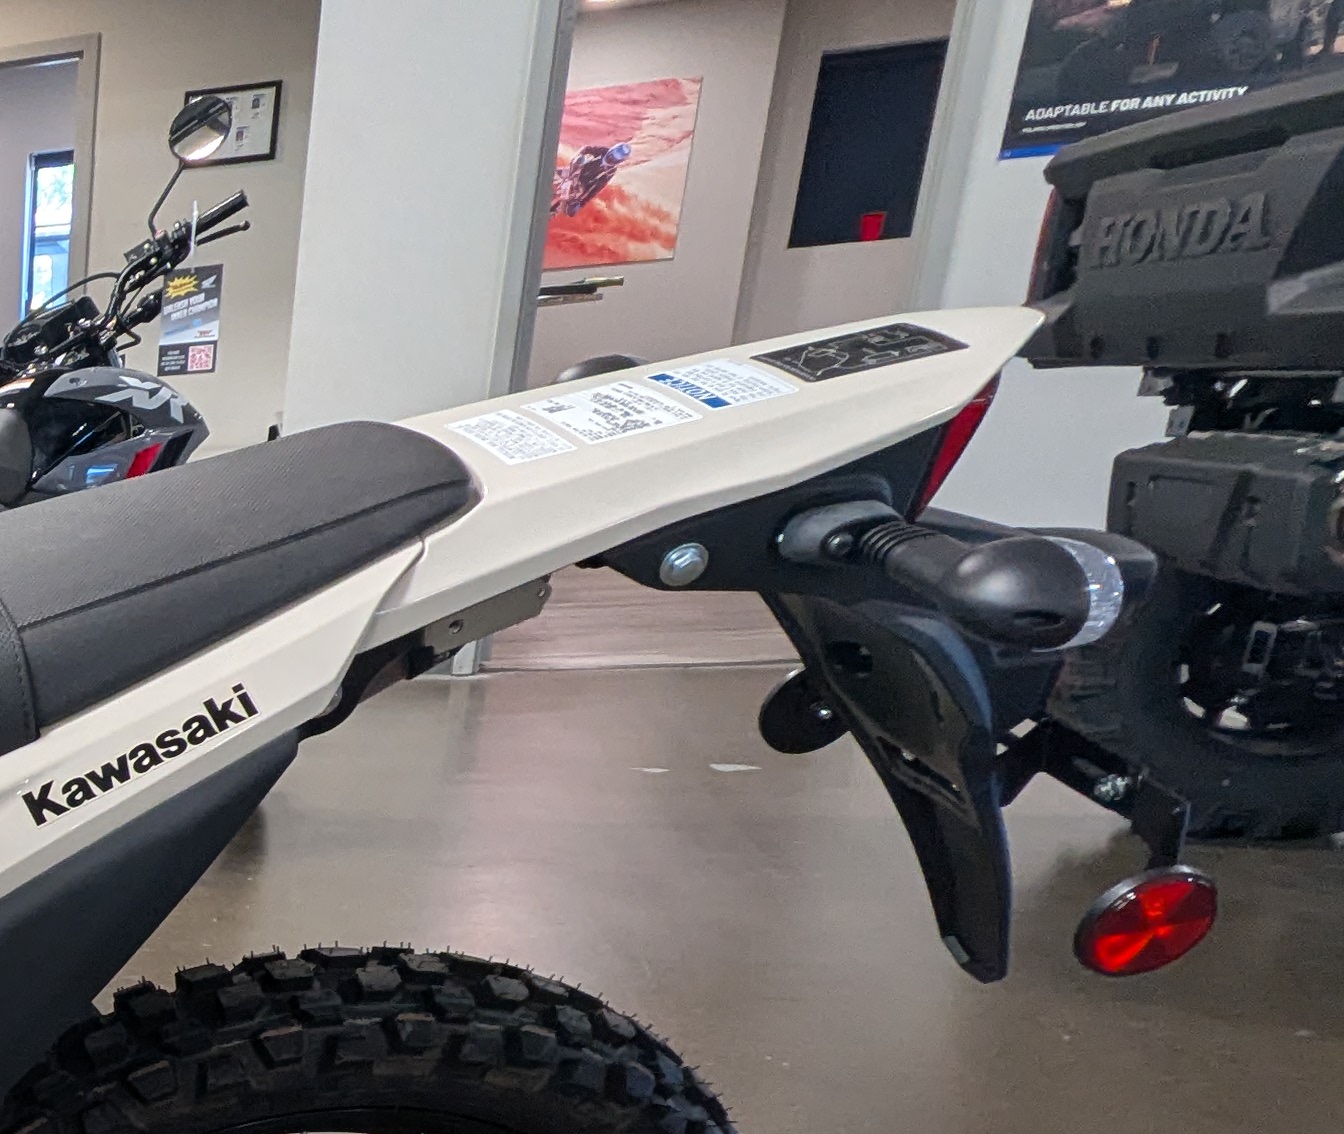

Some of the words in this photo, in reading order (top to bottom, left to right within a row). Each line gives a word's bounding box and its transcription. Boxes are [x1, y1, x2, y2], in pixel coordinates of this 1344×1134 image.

[1024, 101, 1110, 121] ADAPTABLE
[1111, 97, 1140, 112] FOR
[1141, 94, 1176, 109] ANY
[1177, 86, 1249, 104] ACTIVITY
[1093, 195, 1272, 269] HONDA
[21, 682, 259, 827] Kawasaki
